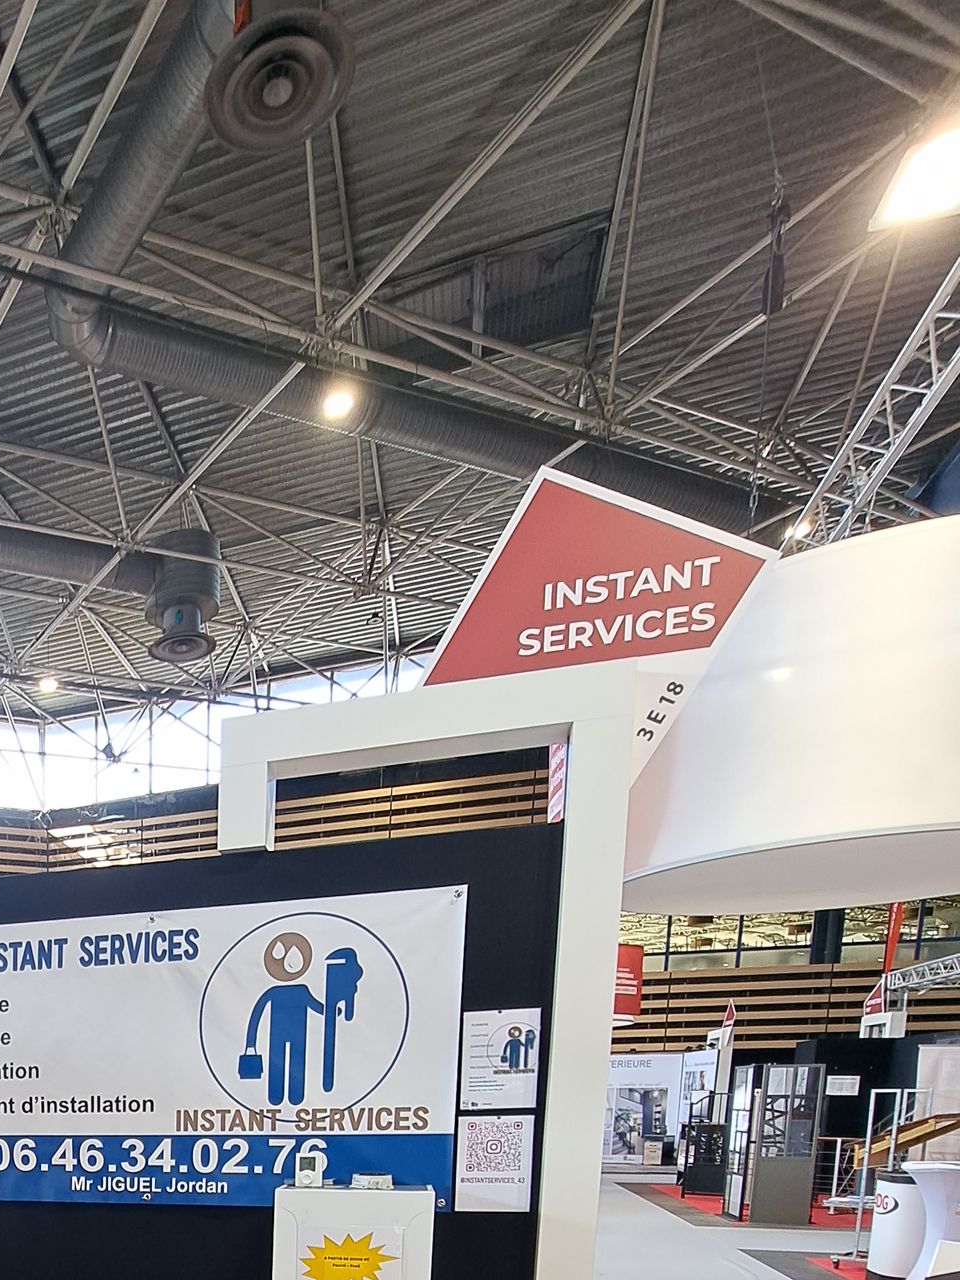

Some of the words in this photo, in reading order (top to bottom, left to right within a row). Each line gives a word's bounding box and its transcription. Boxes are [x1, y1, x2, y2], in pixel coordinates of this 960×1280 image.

[542, 556, 721, 610] INSTANT
[517, 602, 717, 657] SERVICES
[79, 928, 200, 968] SERVICES
[21, 1095, 155, 1115] d'installation
[175, 1109, 282, 1133] INSTANT
[294, 1106, 430, 1132] SERVICES
[71, 1177, 93, 1192] Mr
[97, 1177, 162, 1194] JIGUEL
[166, 1178, 229, 1194] Jordan
